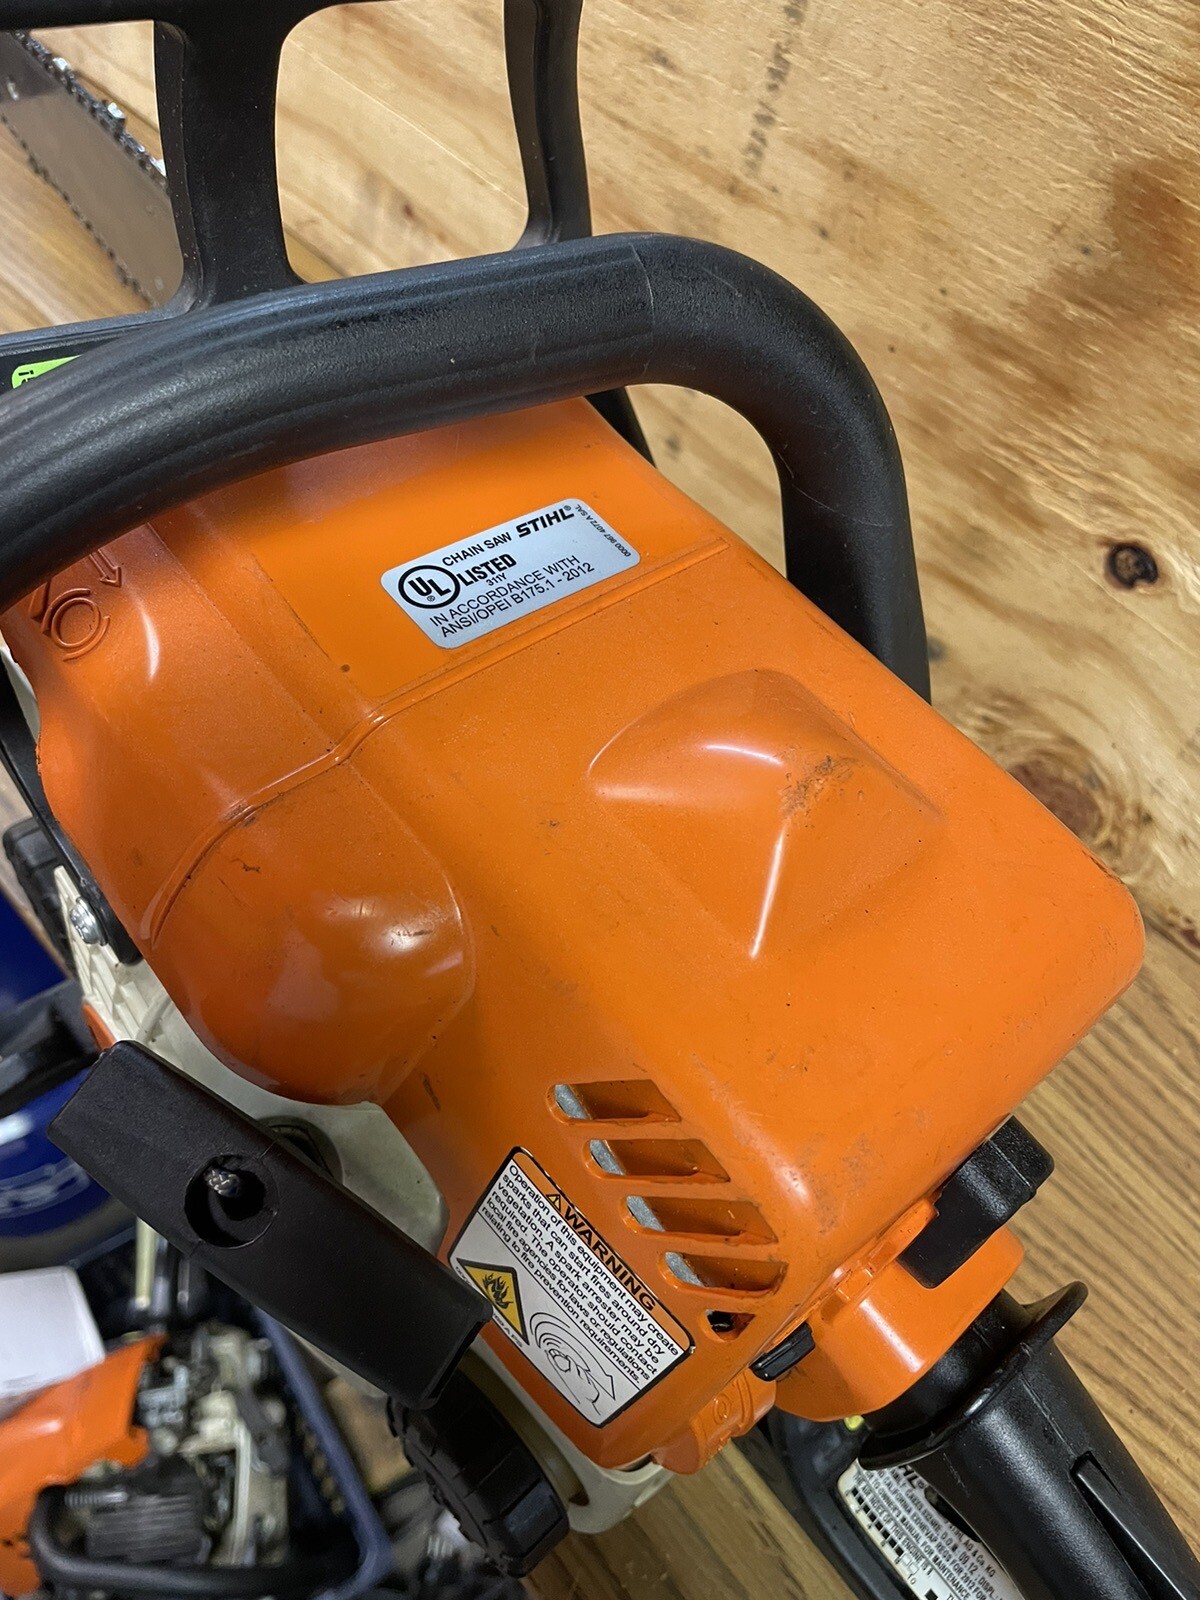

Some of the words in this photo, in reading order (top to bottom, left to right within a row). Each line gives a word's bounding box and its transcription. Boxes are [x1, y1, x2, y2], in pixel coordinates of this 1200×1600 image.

[442, 543, 485, 567] CHAIN
[483, 531, 512, 549] SAW
[574, 503, 589, 517] SAL
[429, 612, 449, 627] IN
[448, 569, 546, 620] ACCORDANCE
[542, 554, 581, 576] WITH
[440, 597, 513, 638] ANSI/OPEI
[509, 578, 556, 605] B175.1
[561, 561, 595, 582] 2012
[455, 553, 517, 585] LISTED
[485, 572, 507, 587] 311Y
[481, 1206, 512, 1243] relating
[511, 1240, 521, 1253] to
[520, 1251, 535, 1269] fire
[533, 1268, 580, 1320] prevention
[578, 1314, 640, 1387] requirements.
[486, 1197, 507, 1223] local
[505, 1220, 519, 1238] fire
[518, 1237, 557, 1281] agencies
[555, 1278, 571, 1294] for
[568, 1292, 590, 1318] laws
[589, 1316, 602, 1329] or
[599, 1323, 651, 1381] regulations
[491, 1190, 529, 1237] required.
[531, 1233, 548, 1258] The
[548, 1257, 588, 1300] operator
[586, 1300, 621, 1337] should
[619, 1336, 658, 1375] contact
[497, 1181, 544, 1241] vegetation.
[544, 1240, 554, 1252] A
[554, 1249, 583, 1282] spark
[581, 1281, 621, 1323] arrester
[620, 1323, 645, 1348] may
[643, 1347, 659, 1364] be
[502, 1173, 532, 1210] sparks
[531, 1207, 551, 1232] that
[549, 1230, 568, 1252] can
[567, 1250, 591, 1277] start
[589, 1274, 612, 1300] fires
[610, 1299, 649, 1338] around
[646, 1337, 666, 1355] dry
[508, 1164, 551, 1216] Operation
[549, 1214, 563, 1227] of
[559, 1224, 578, 1246] this
[576, 1245, 627, 1301] equipment
[624, 1298, 649, 1323] may
[646, 1322, 679, 1356] create
[564, 1205, 656, 1314] WARNING
